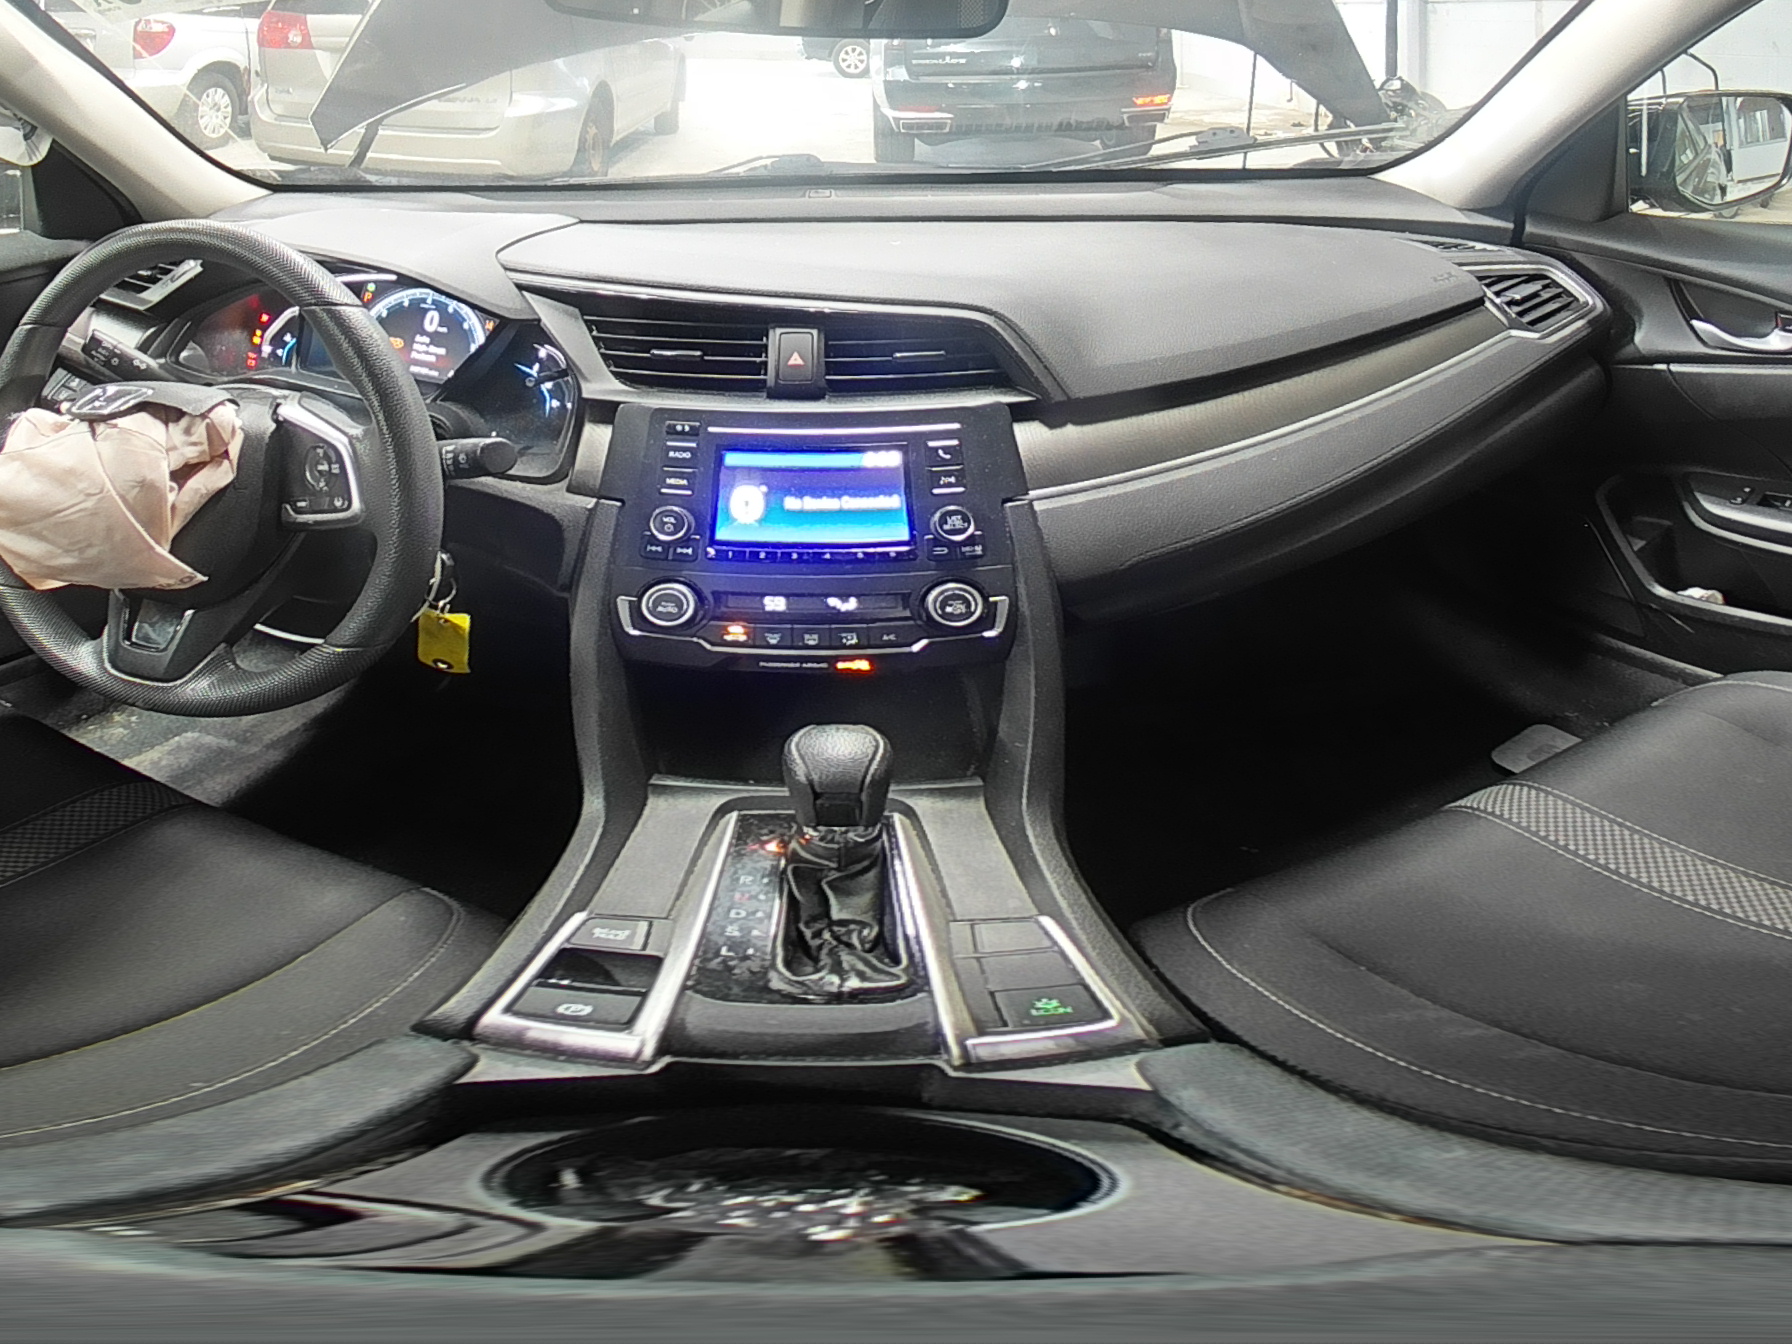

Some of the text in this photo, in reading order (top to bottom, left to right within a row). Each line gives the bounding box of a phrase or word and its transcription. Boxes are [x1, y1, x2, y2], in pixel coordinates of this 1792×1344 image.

[423, 310, 440, 333] 0
[668, 451, 692, 459] RADIO
[739, 875, 754, 885] R
[729, 908, 746, 918] D
[720, 945, 736, 957] L
